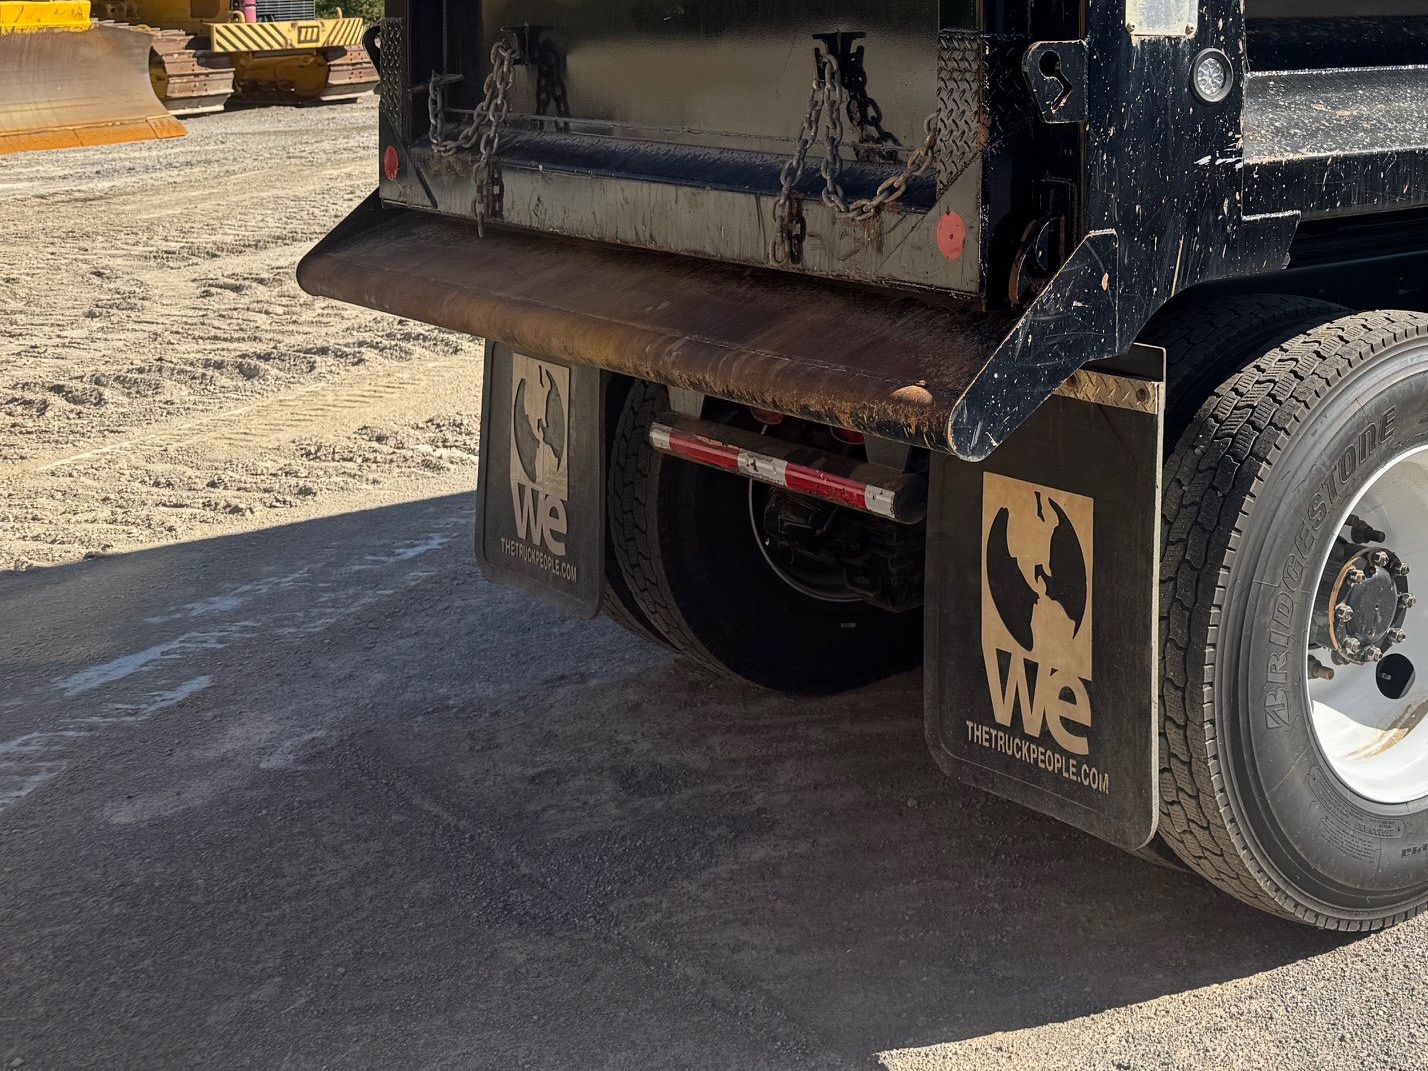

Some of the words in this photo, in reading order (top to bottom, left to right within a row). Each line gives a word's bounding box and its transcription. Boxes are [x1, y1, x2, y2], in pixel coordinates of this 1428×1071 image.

[500, 537, 578, 584] THETRUCKPEOPLE.COM
[1261, 403, 1397, 731] BRIDGESTONE
[965, 719, 1110, 796] THETRUCKPEOPLE.COM
